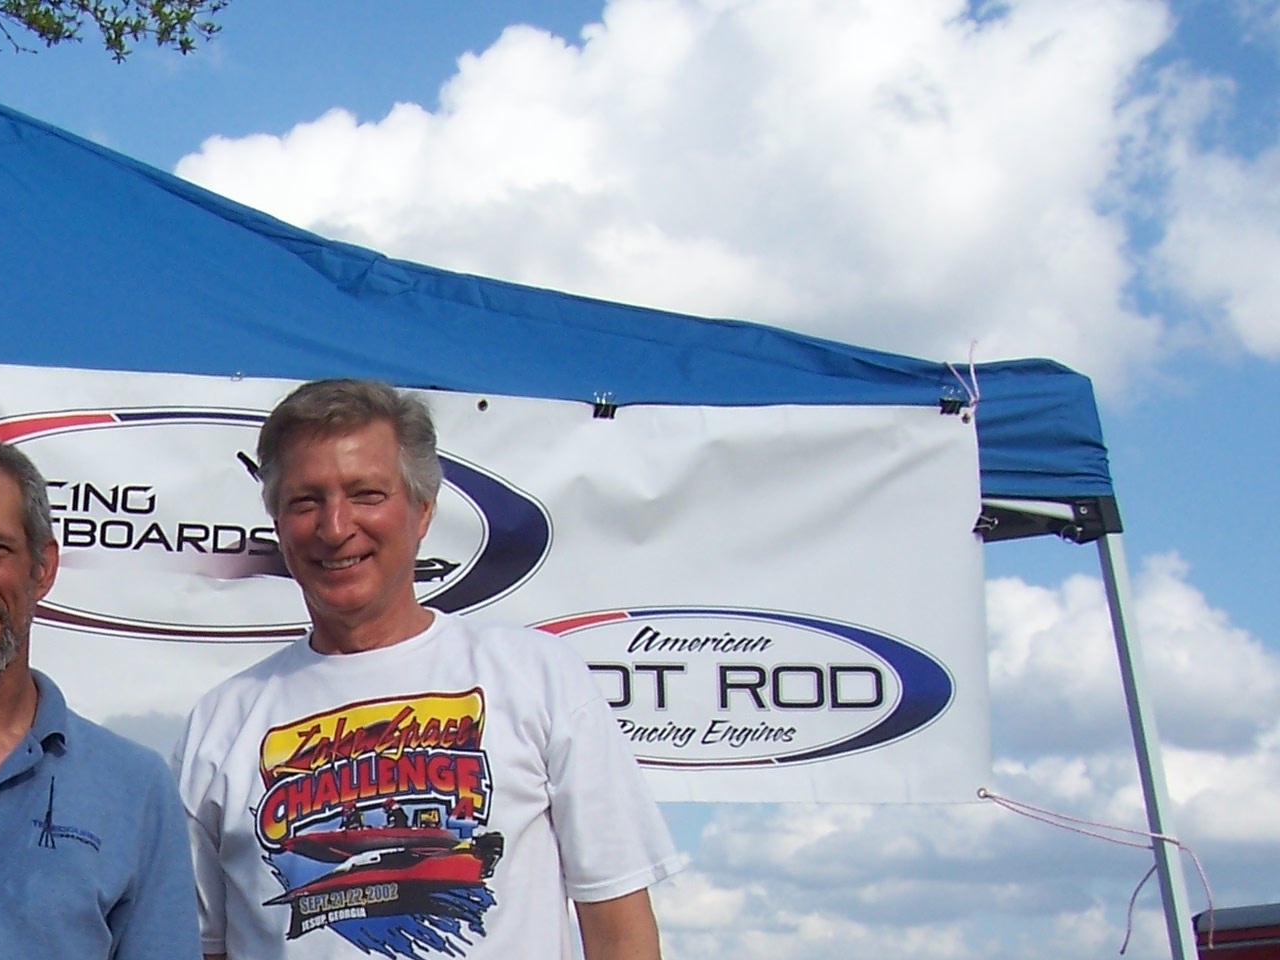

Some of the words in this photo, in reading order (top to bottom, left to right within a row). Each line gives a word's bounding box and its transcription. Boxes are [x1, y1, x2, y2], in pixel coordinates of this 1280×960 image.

[51, 516, 281, 556] BOARDS
[627, 626, 772, 653] American
[718, 665, 884, 709] ROD
[273, 714, 368, 778] Lake
[372, 705, 475, 761] Grace
[700, 719, 797, 748] Engines
[262, 754, 484, 841] CHALLENGE
[328, 907, 367, 923] GEORGIA
